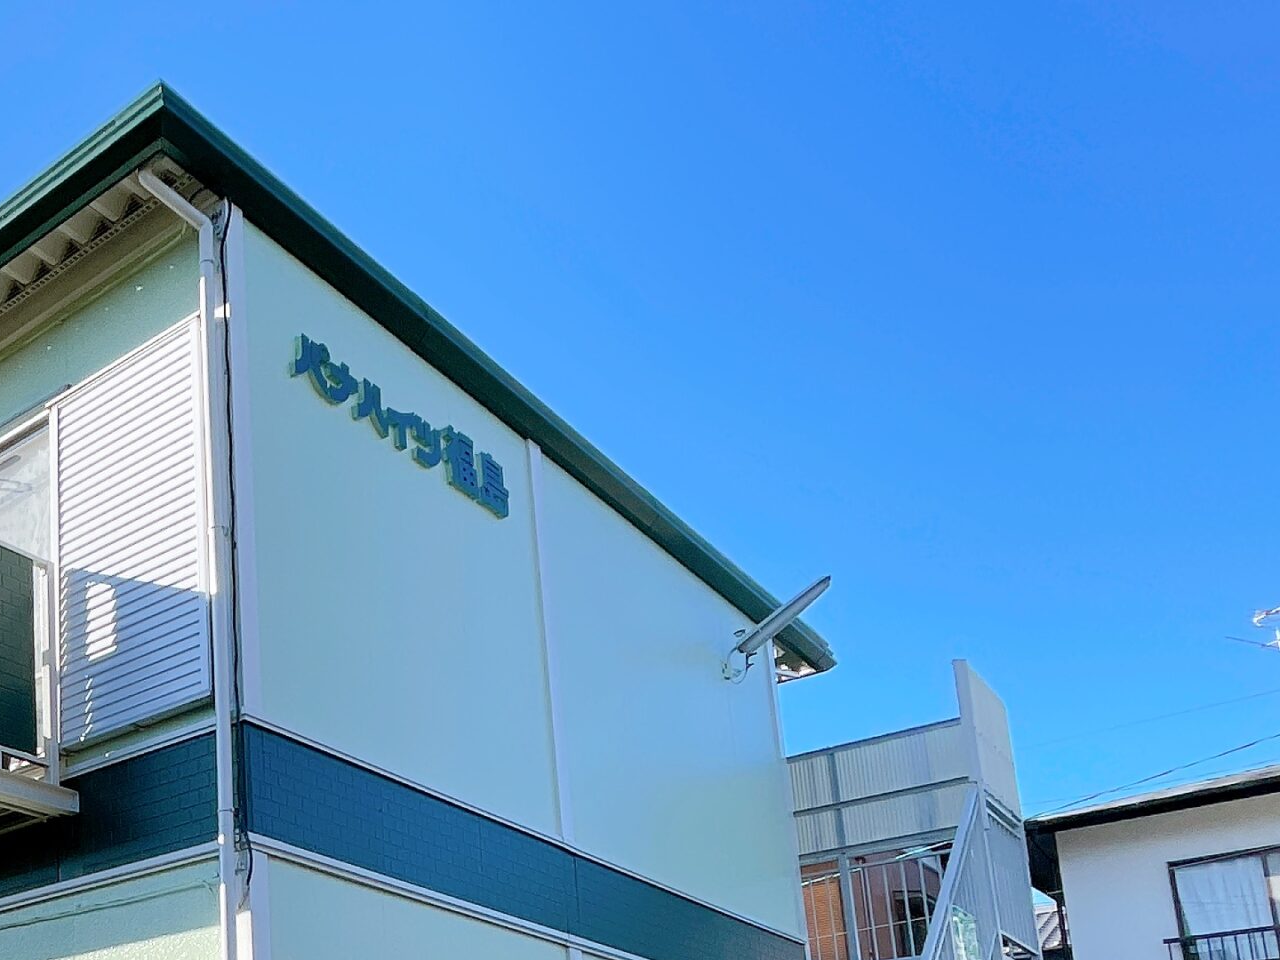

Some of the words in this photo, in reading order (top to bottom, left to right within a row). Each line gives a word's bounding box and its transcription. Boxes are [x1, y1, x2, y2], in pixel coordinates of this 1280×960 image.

[290, 333, 509, 519] パナハイツ福島
